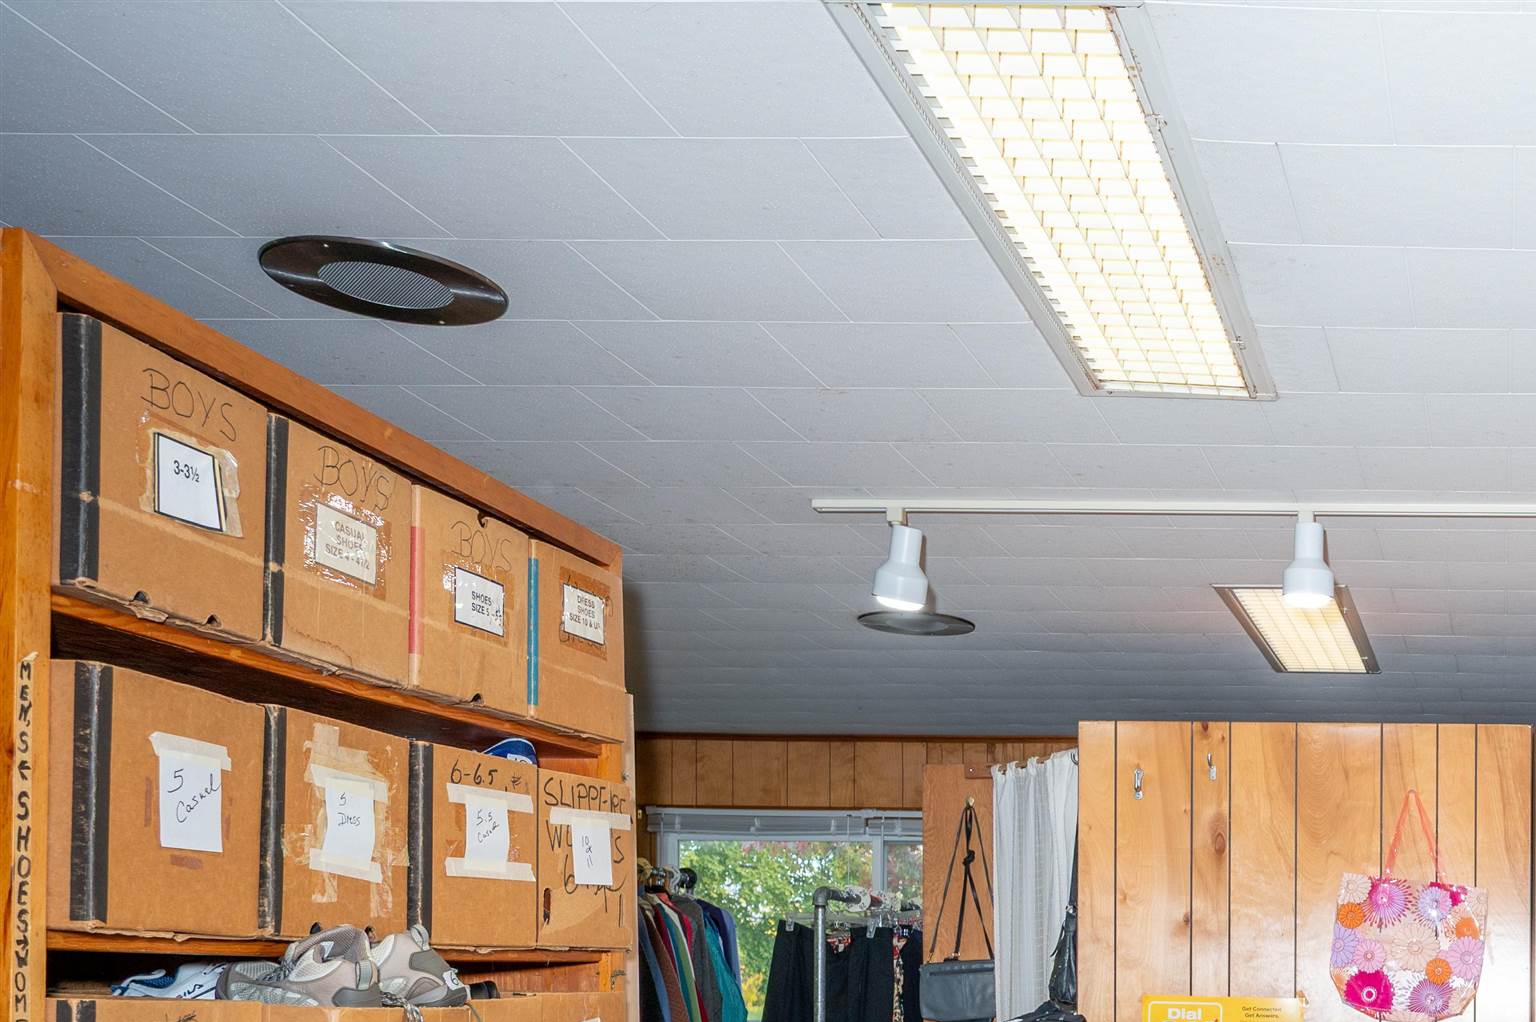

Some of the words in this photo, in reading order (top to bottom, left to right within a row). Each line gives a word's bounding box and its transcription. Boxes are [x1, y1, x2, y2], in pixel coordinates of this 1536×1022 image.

[141, 368, 237, 442] BOYS
[313, 445, 390, 511] BOYS
[450, 521, 512, 572] BOYS
[471, 590, 492, 607] SHOES
[471, 602, 486, 616] SIZE
[167, 768, 185, 794] 5
[175, 773, 220, 824] Casual
[16, 789, 32, 935] SHOES
[450, 971, 459, 986] 6
[1167, 1007, 1203, 1020] Dial
